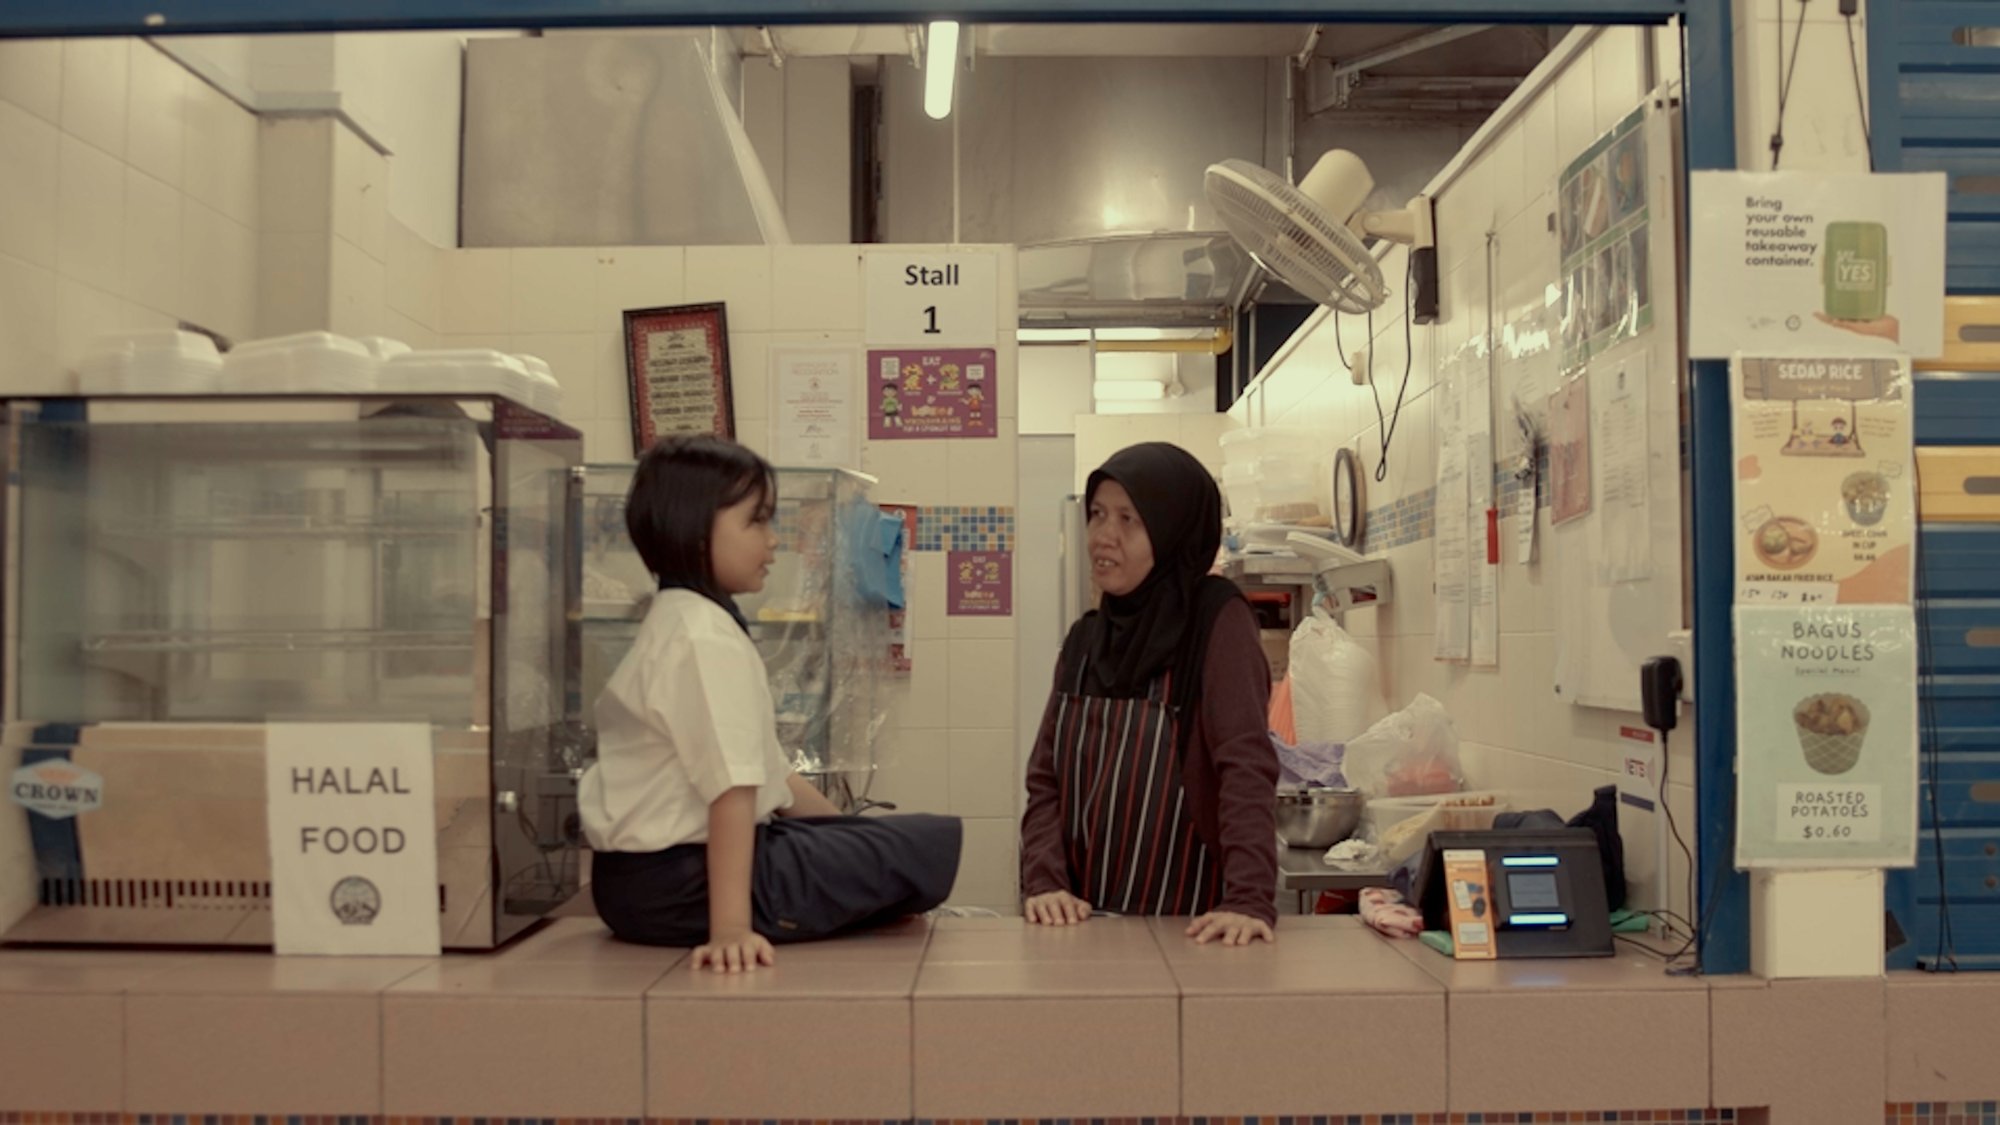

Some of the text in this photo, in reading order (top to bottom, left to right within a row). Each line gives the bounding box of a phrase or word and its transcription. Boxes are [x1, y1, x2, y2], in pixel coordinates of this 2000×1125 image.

[1745, 196, 1783, 212] Bring
[1745, 213, 1814, 225] your own
[1745, 225, 1807, 238] reusable
[1744, 240, 1818, 255] takeaway
[1744, 254, 1815, 267] container.
[904, 263, 960, 287] Stall
[1839, 263, 1872, 283] YES
[923, 304, 942, 335] 1
[1778, 363, 1863, 381] SEDAP RICE
[1792, 620, 1862, 640] BAGUS
[1780, 644, 1875, 662] NOODLES
[291, 765, 412, 795] HALAL
[14, 782, 99, 803] CROWN
[1795, 790, 1866, 805] ROASTED
[1791, 803, 1869, 818] POTATOES
[300, 825, 407, 855] FOOD
[1802, 824, 1852, 839] $0.60
